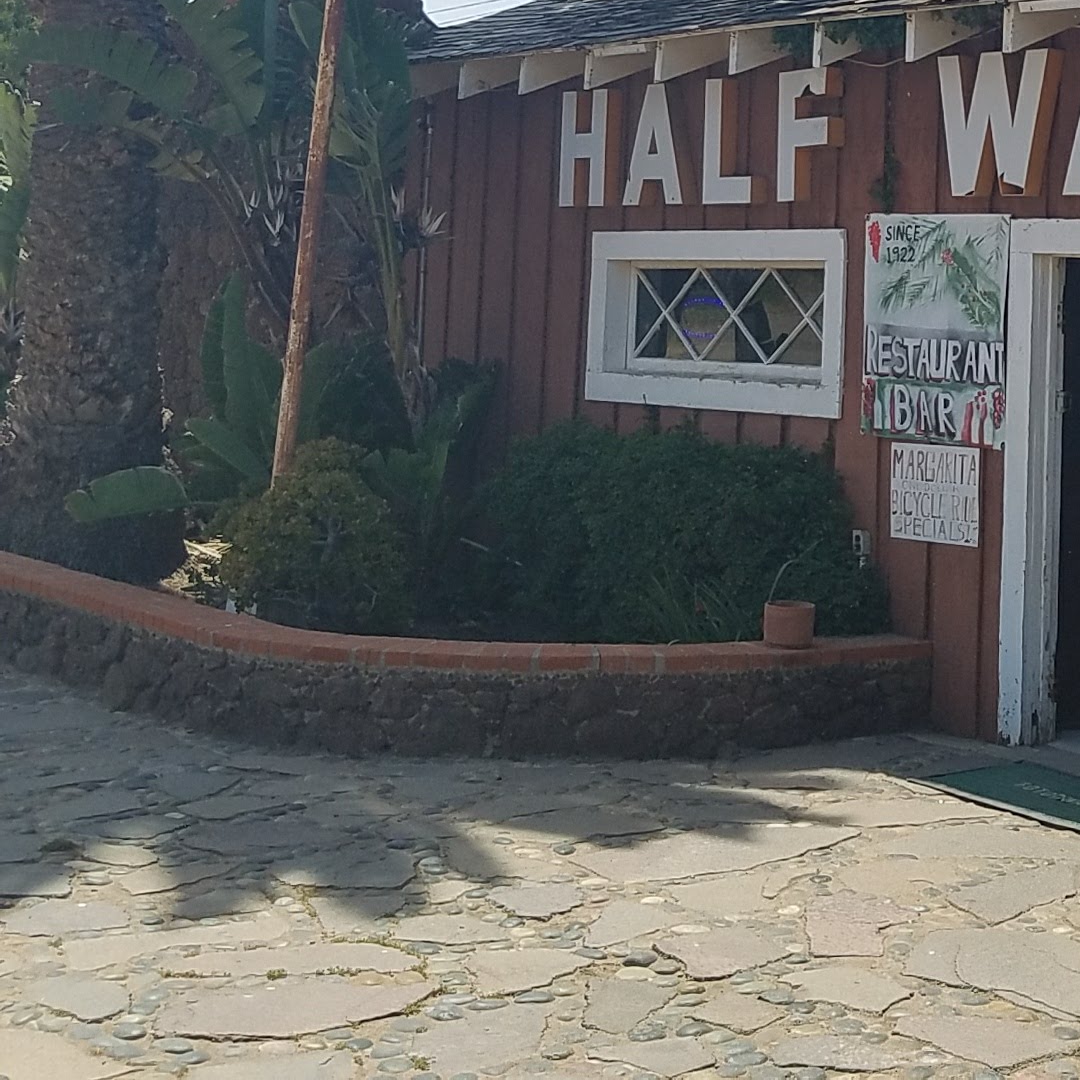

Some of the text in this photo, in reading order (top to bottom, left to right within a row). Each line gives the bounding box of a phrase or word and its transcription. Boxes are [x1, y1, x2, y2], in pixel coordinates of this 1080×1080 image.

[559, 66, 829, 208] HALF
[885, 224, 921, 242] SINCE
[886, 246, 916, 264] 1922
[866, 324, 1005, 385] RESTAURANT
[894, 383, 956, 434] BAR
[892, 448, 977, 486] MARGARITA
